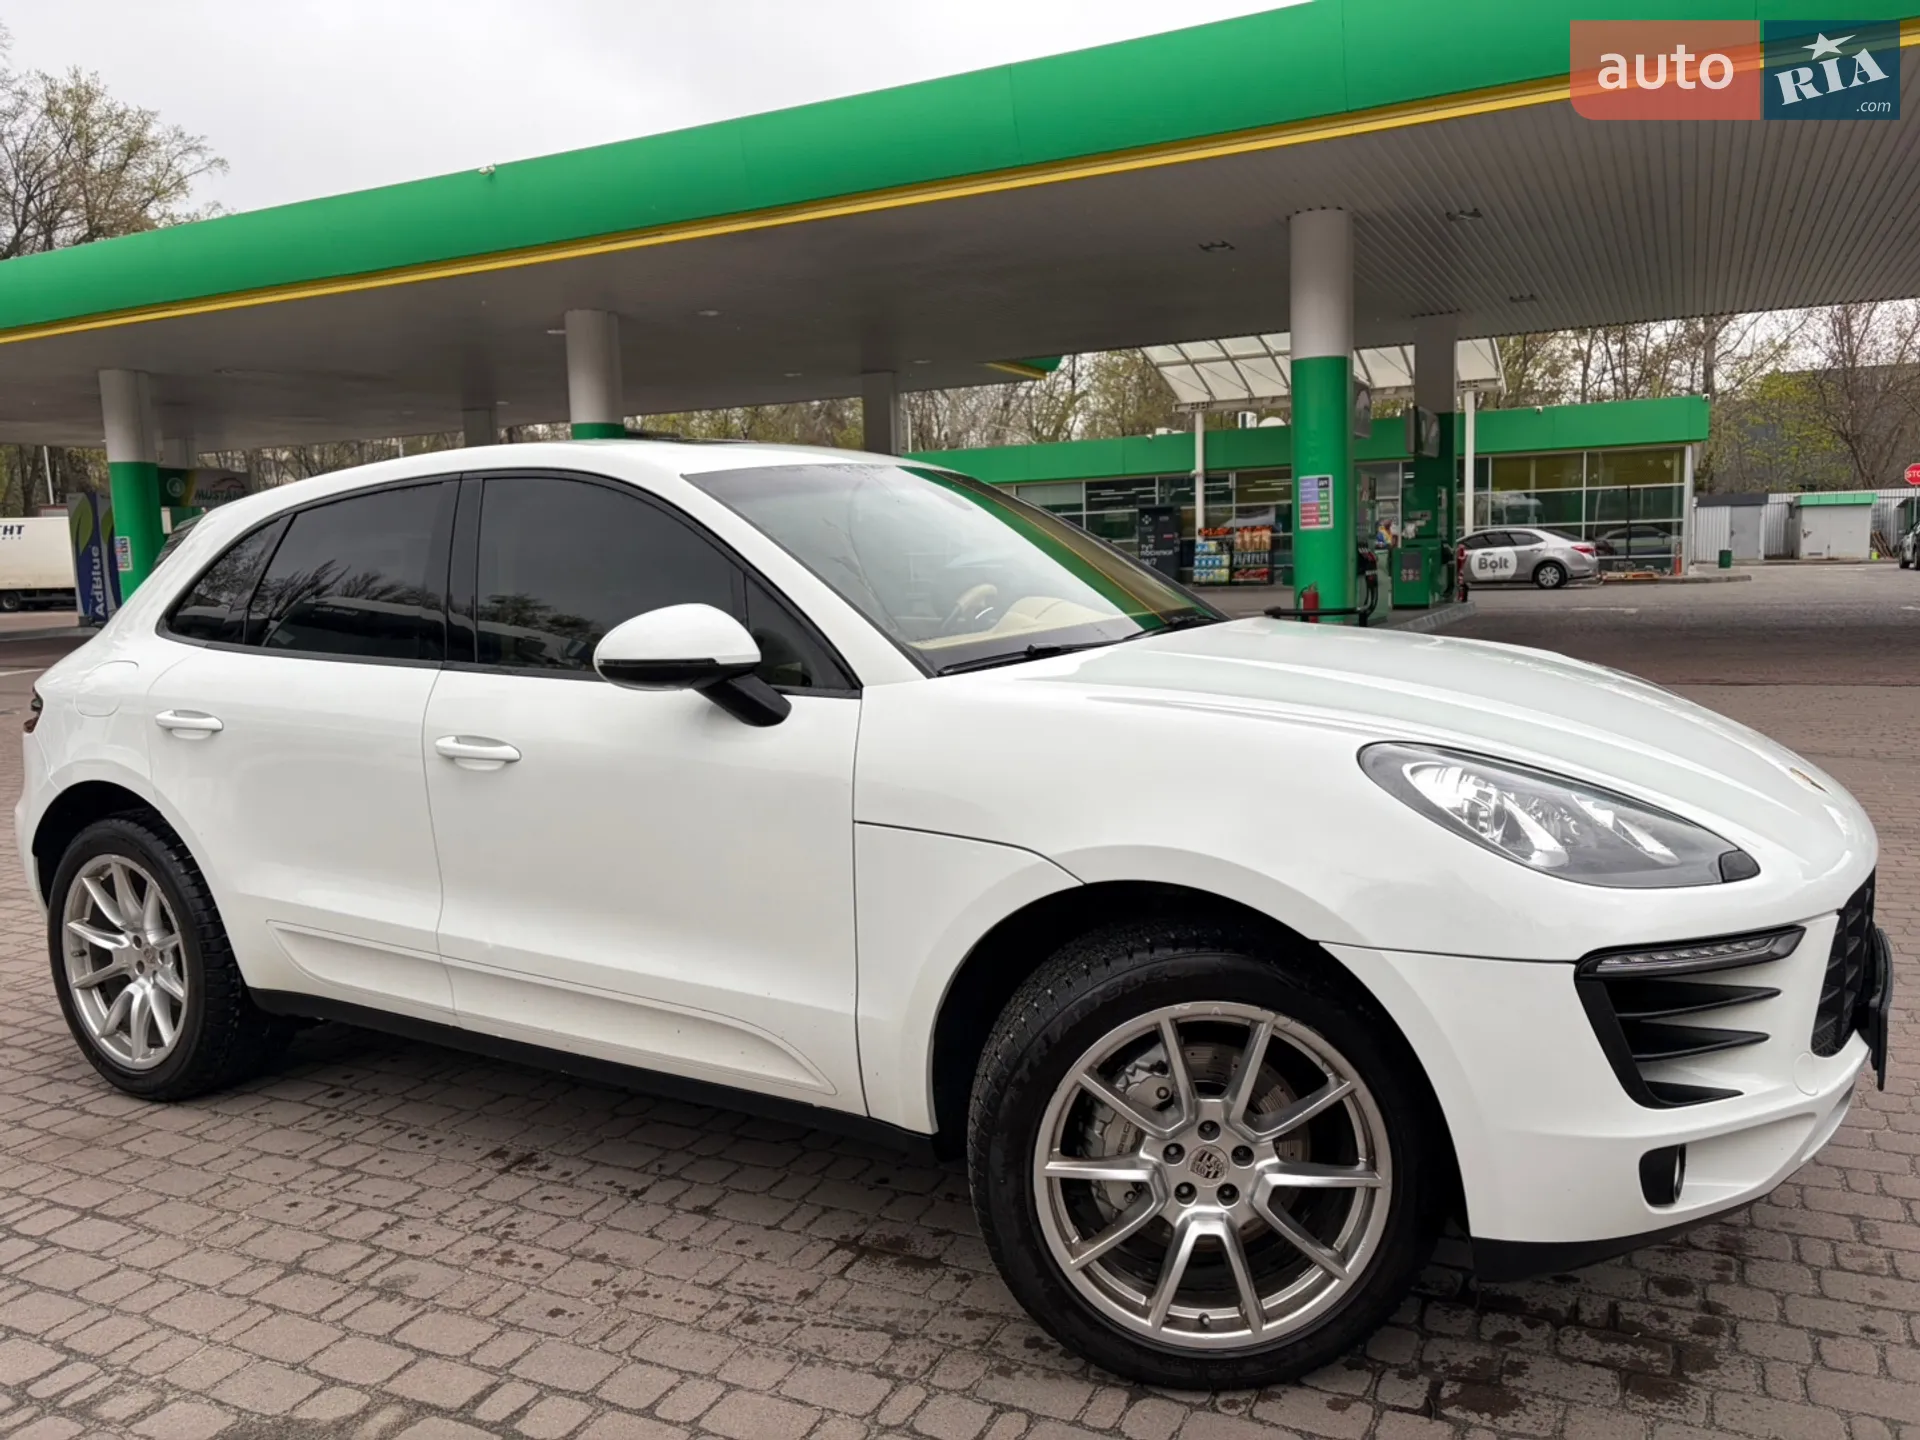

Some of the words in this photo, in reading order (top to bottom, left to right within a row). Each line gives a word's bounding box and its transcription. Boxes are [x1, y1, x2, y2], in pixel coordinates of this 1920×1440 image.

[194, 488, 240, 501] MUSTAN
[0, 524, 25, 536] HT
[1478, 556, 1509, 570] Bolt
[91, 545, 105, 616] AdBlue
